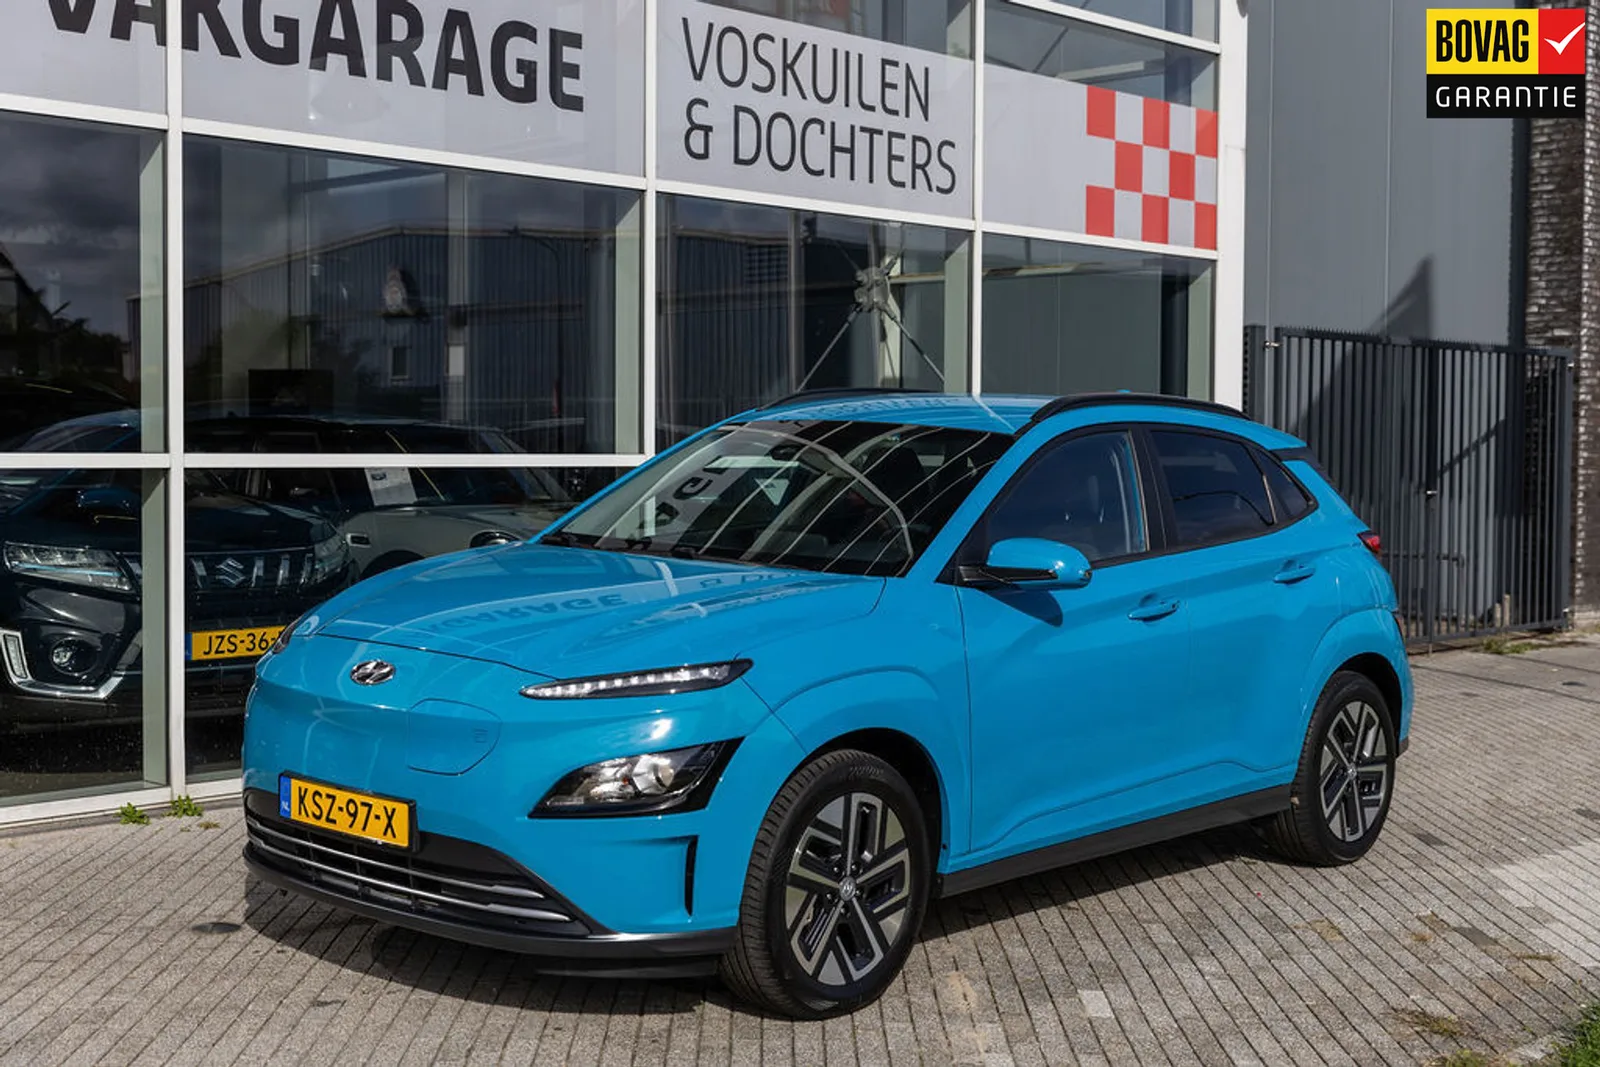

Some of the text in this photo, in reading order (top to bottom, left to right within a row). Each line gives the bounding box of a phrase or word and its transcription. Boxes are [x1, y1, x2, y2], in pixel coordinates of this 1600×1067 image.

[682, 17, 929, 122] VOSKUILEN
[685, 98, 956, 195] & DOCHTERS
[298, 786, 397, 838] KSZ-97-X
